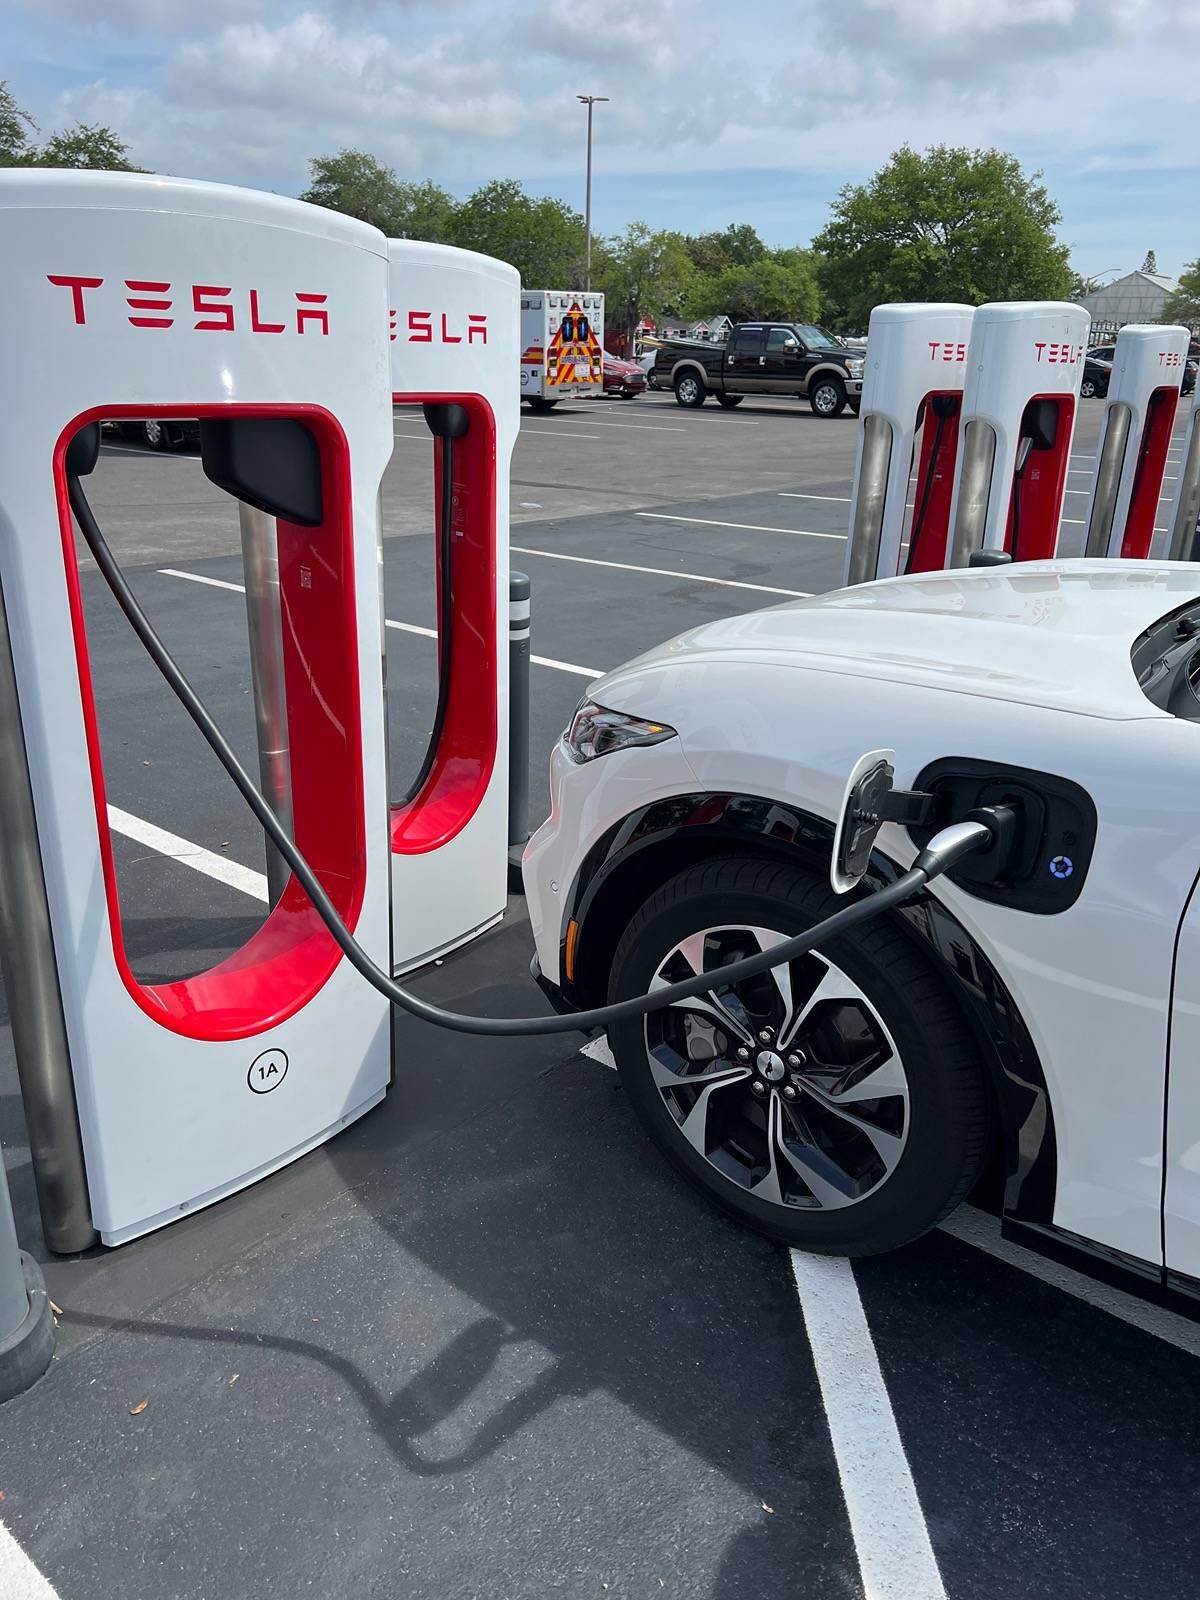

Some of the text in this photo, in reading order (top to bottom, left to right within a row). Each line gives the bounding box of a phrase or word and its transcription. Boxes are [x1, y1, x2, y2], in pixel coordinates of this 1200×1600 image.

[47, 275, 328, 335] TESLA
[389, 310, 487, 344] SLA
[1035, 343, 1083, 363] TESLA
[258, 1062, 278, 1080] 1A
